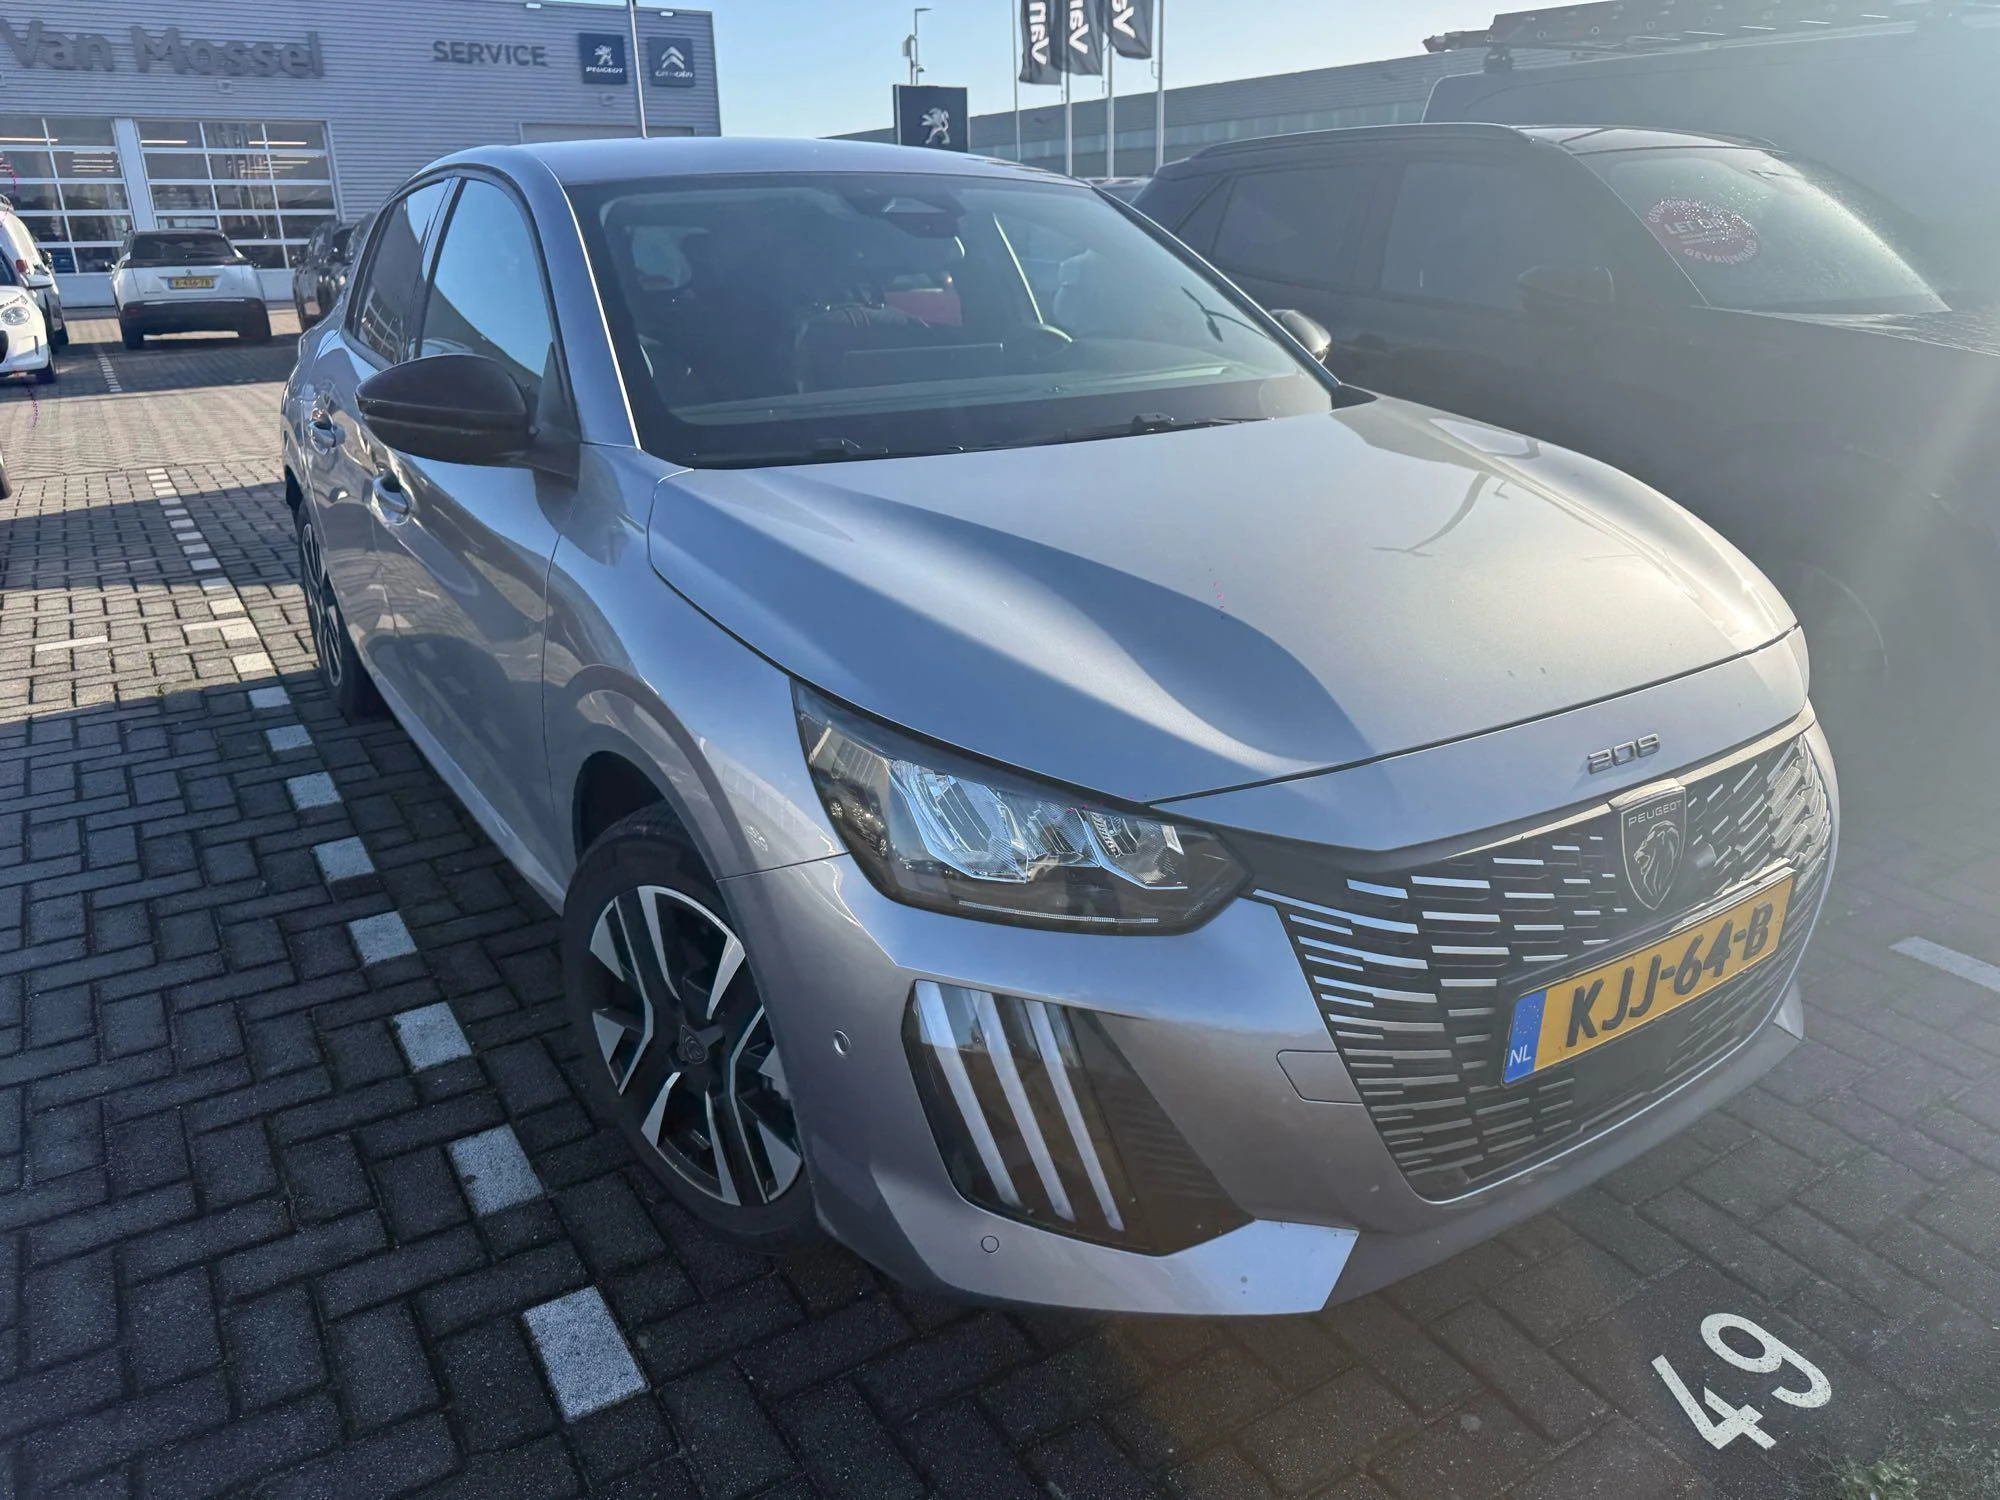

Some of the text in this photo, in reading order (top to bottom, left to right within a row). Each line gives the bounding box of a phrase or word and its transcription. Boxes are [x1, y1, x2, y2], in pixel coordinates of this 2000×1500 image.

[0, 18, 325, 78] Van Mossel
[432, 40, 548, 66] SERVICE
[1664, 220, 1695, 235] LET
[1587, 733, 1661, 775] 208
[1628, 799, 1682, 828] PEUGEOT
[1565, 902, 1774, 1049] KJJ-64-B
[1509, 1045, 1532, 1067] NL
[1651, 1313, 1832, 1451] 49
